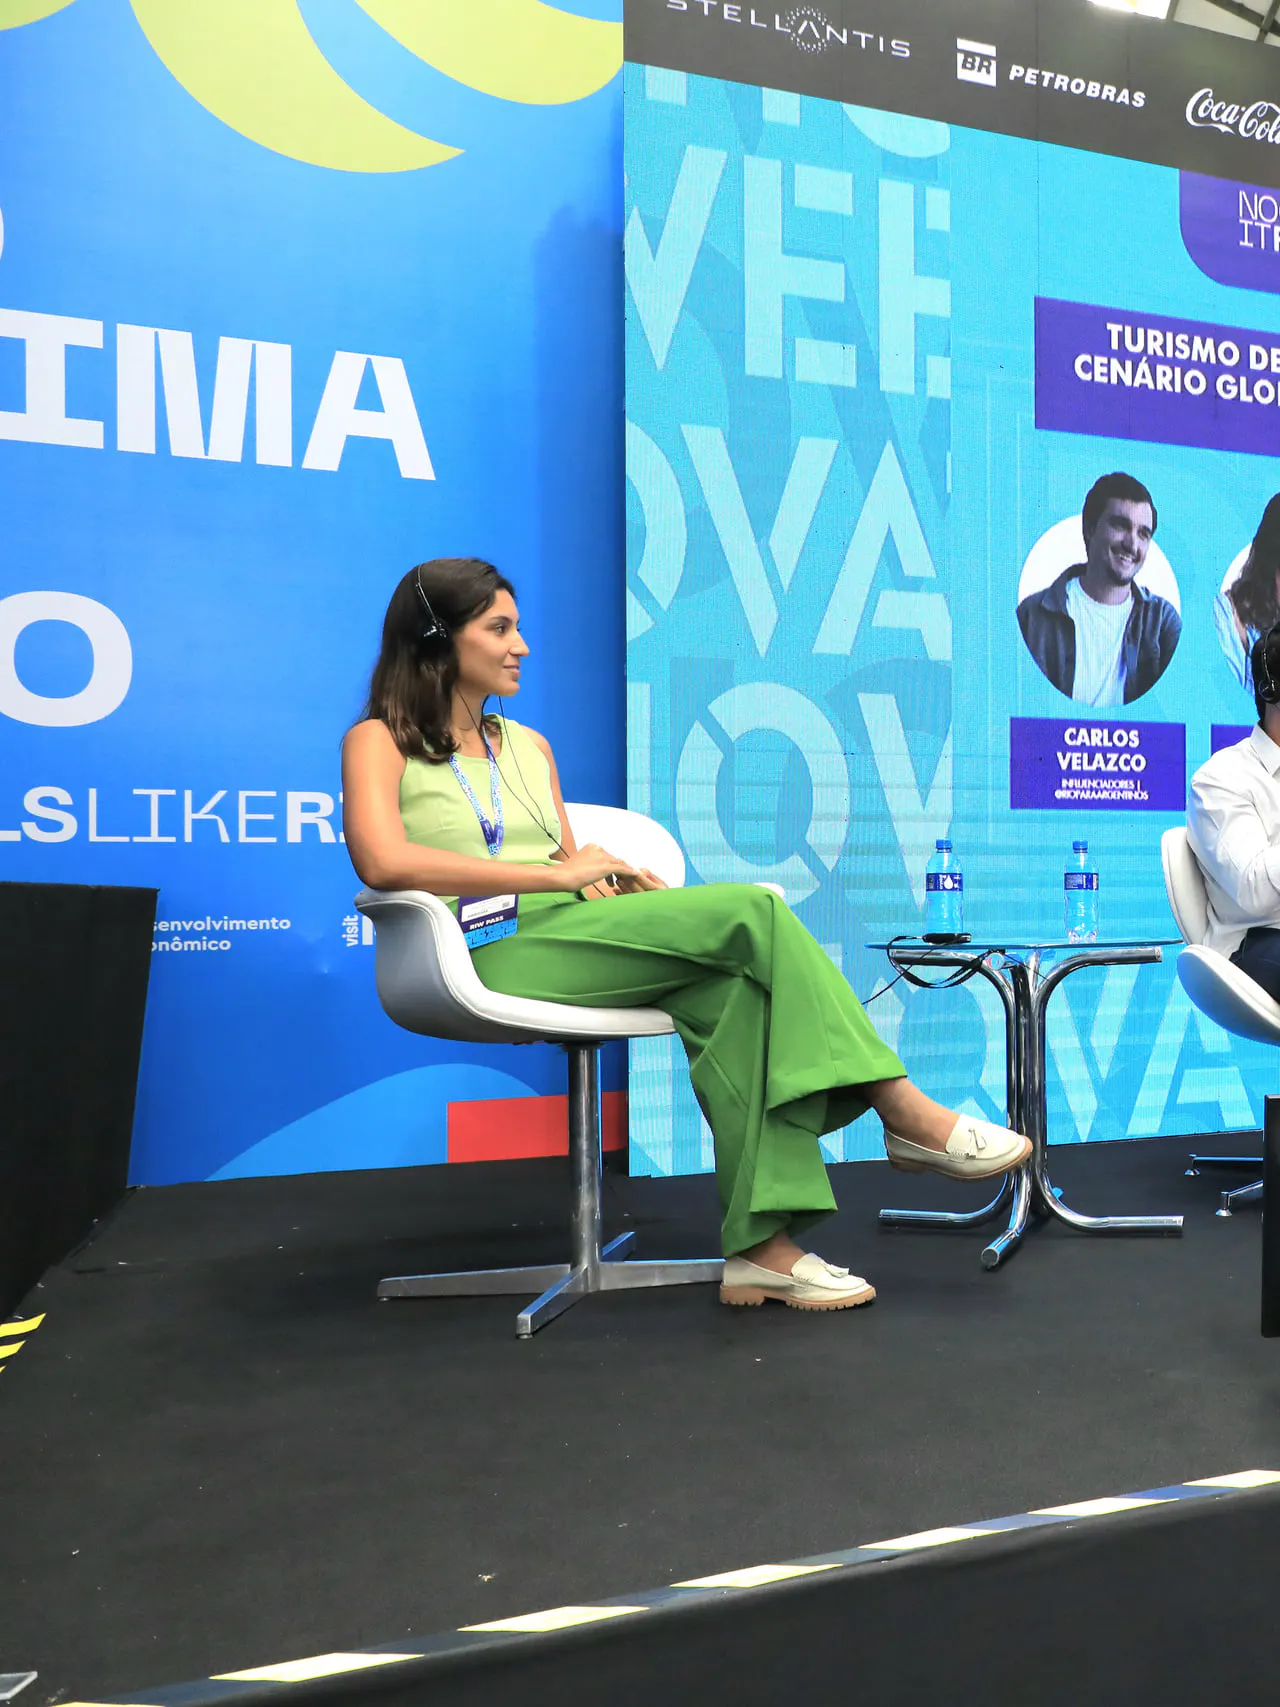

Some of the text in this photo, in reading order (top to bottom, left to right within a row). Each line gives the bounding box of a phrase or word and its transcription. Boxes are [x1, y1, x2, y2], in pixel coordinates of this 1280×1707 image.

[1009, 65, 1145, 107] PETROBRAS
[1107, 323, 1239, 366] TURISMO
[1075, 354, 1206, 395] CENÁRIO
[1065, 728, 1139, 747] CARLOS
[1057, 752, 1146, 771] VELAZCO
[342, 914, 358, 947] visit
